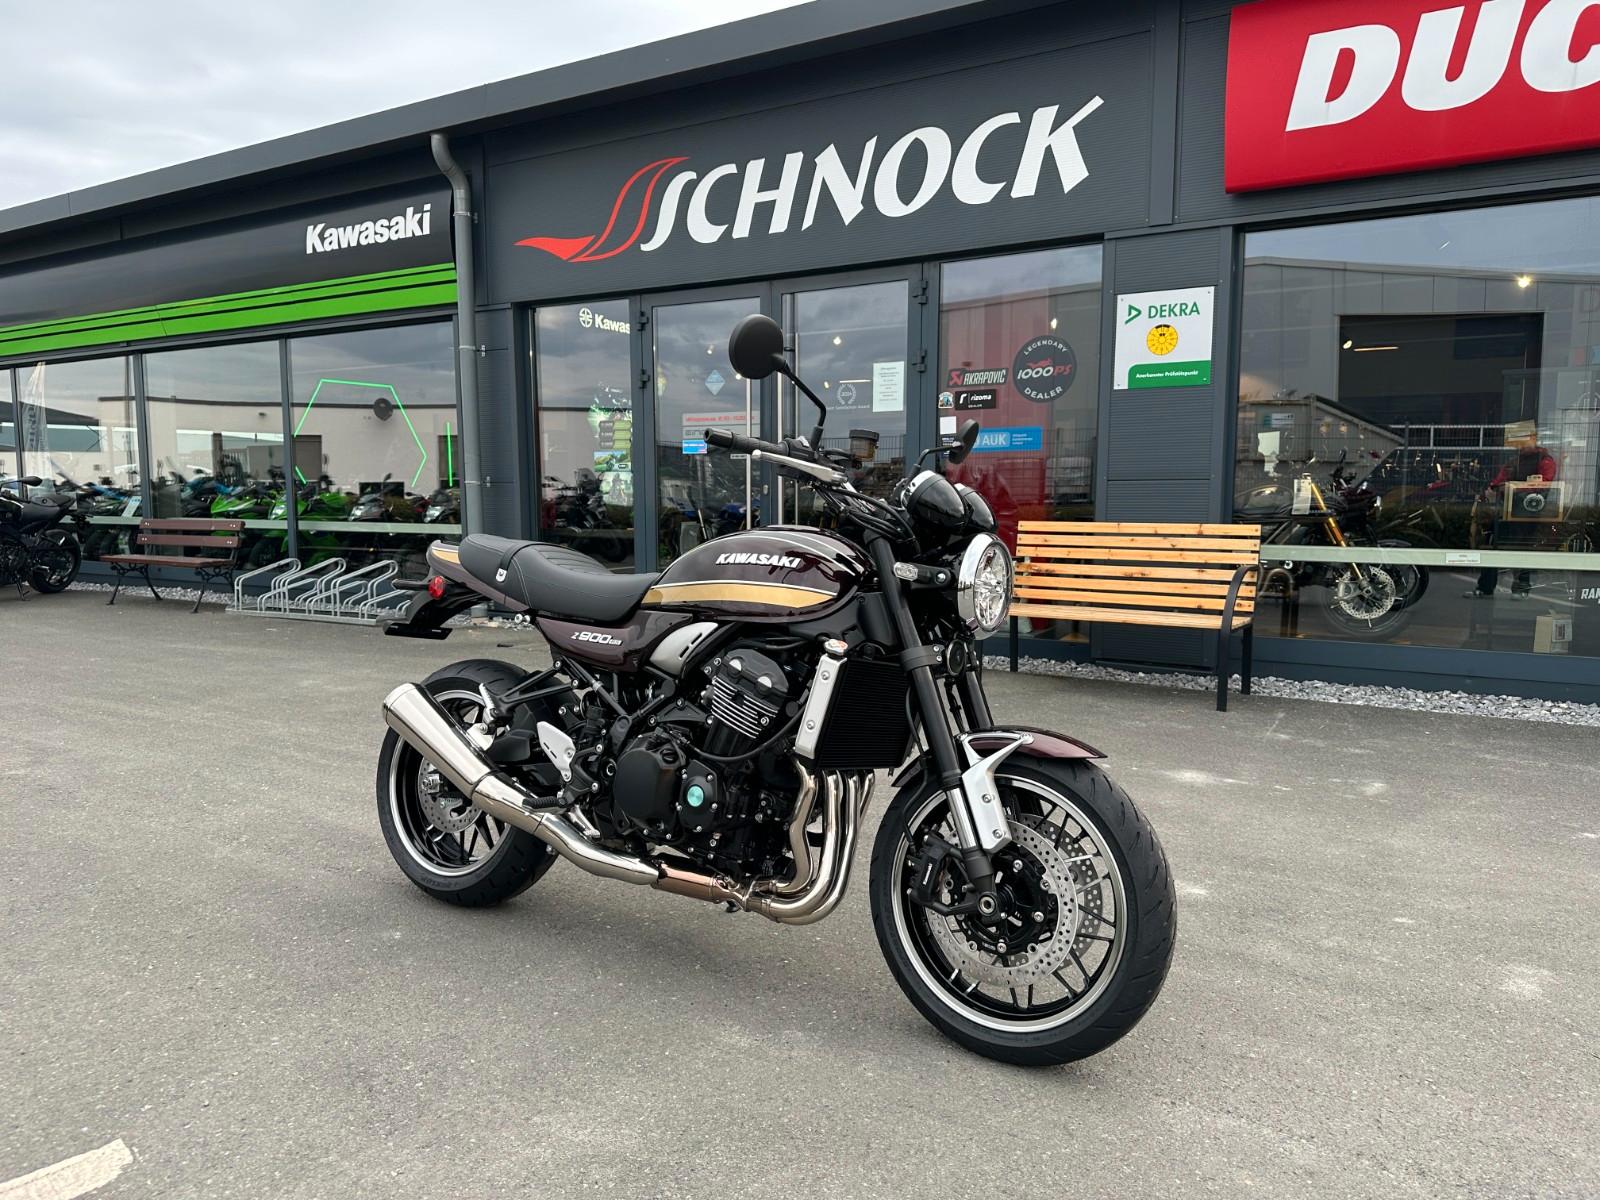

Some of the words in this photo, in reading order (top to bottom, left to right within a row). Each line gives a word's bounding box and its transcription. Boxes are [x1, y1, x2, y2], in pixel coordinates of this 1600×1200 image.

[640, 95, 1104, 252] SCHNOCK
[306, 203, 432, 254] Kawasaki
[1148, 302, 1201, 319] DEKRA
[1023, 339, 1068, 356] LEGENDARY
[1024, 386, 1063, 400] DEALER
[982, 434, 1006, 446] AUK
[715, 552, 802, 569] KAWASAKI
